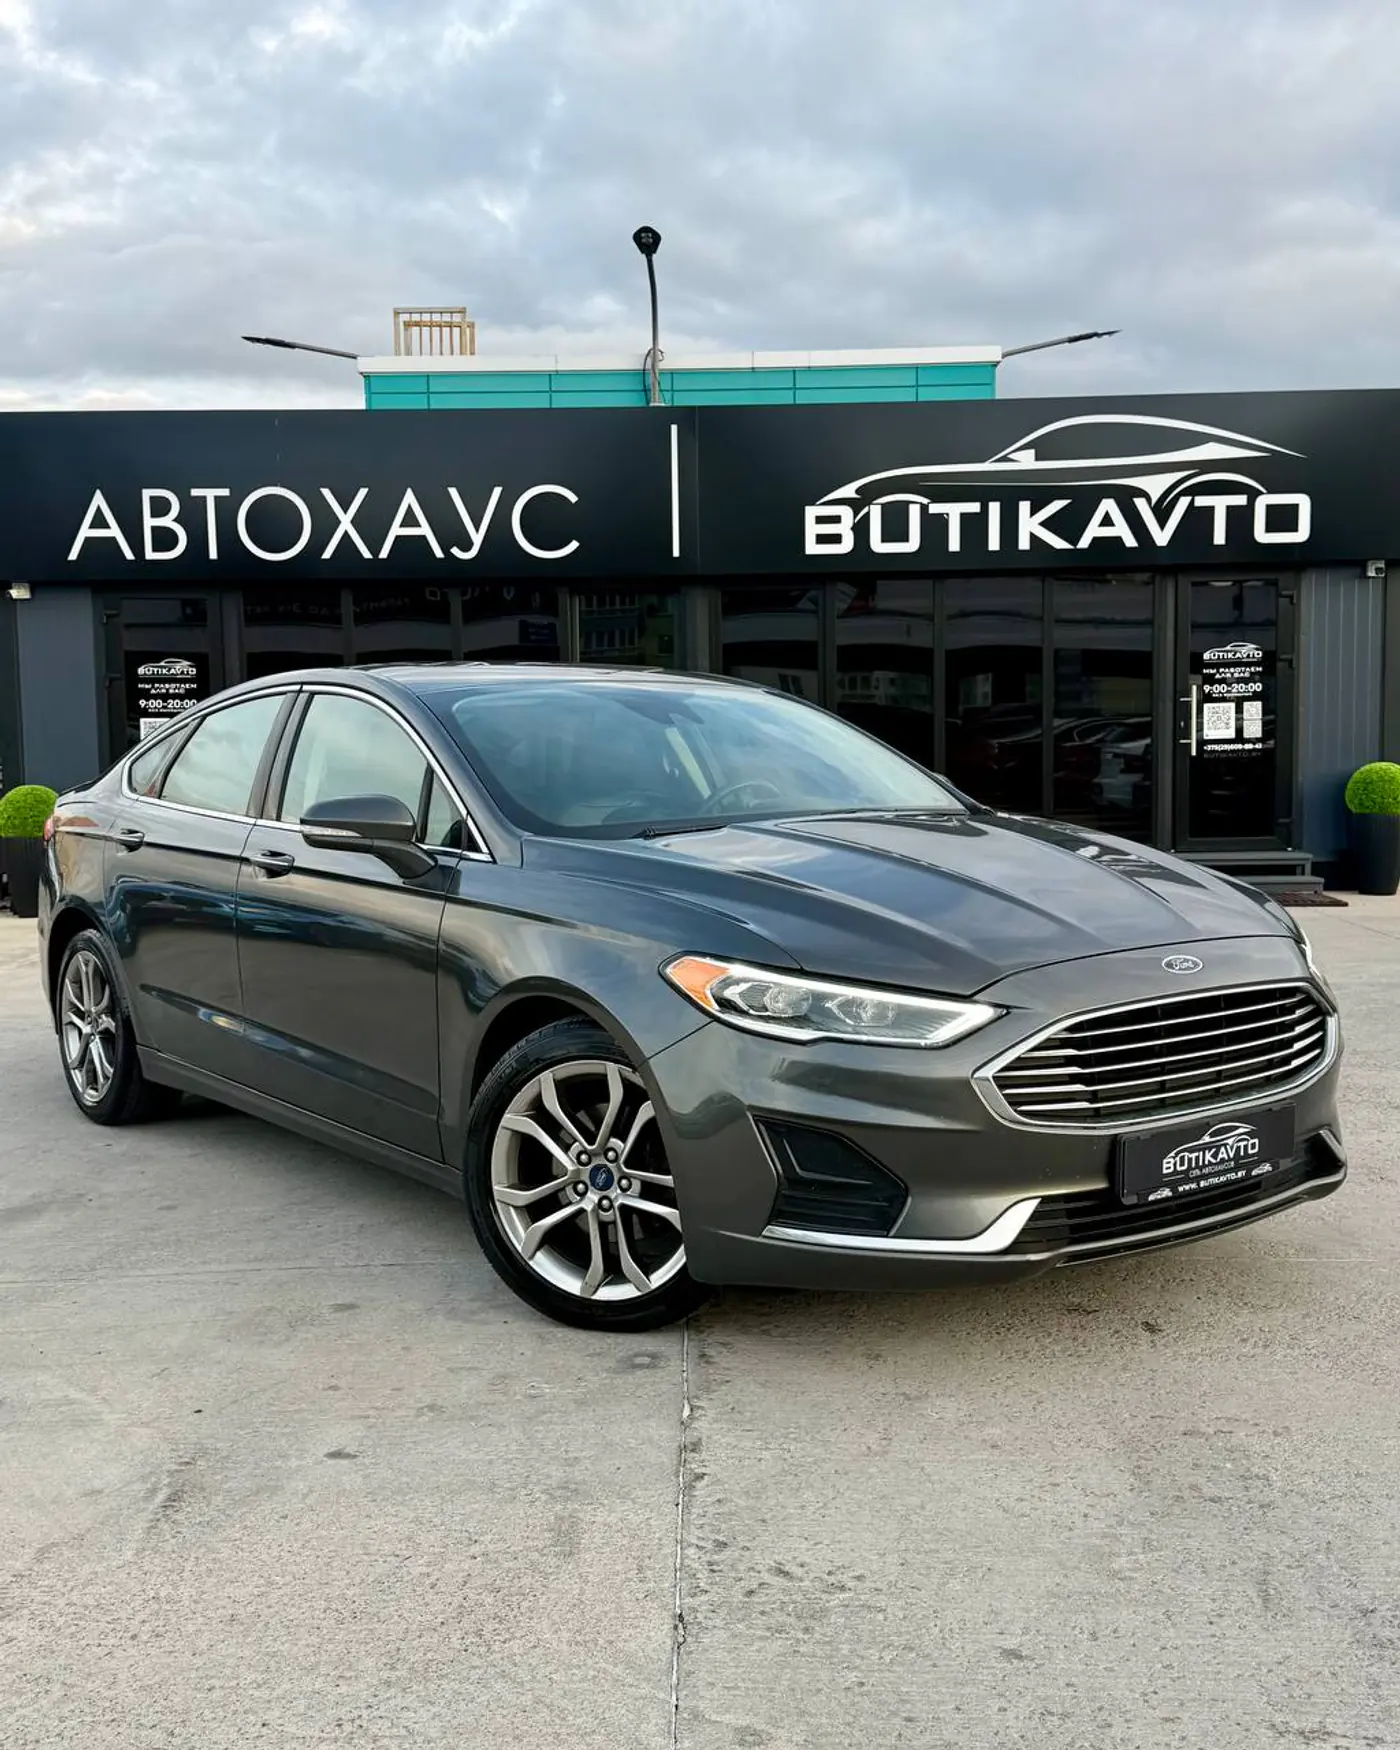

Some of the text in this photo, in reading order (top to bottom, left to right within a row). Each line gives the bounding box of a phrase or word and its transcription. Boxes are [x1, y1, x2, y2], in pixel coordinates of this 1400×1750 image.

[67, 484, 580, 561] АВТОХАУС
[804, 493, 1311, 555] BUTIKAVTO
[1203, 650, 1263, 660] BUTIKAVTO
[137, 667, 197, 675] BUTIKAVTO
[1203, 682, 1263, 694] 9:00-20:00
[1162, 1138, 1259, 1174] BUTIKAVTO
